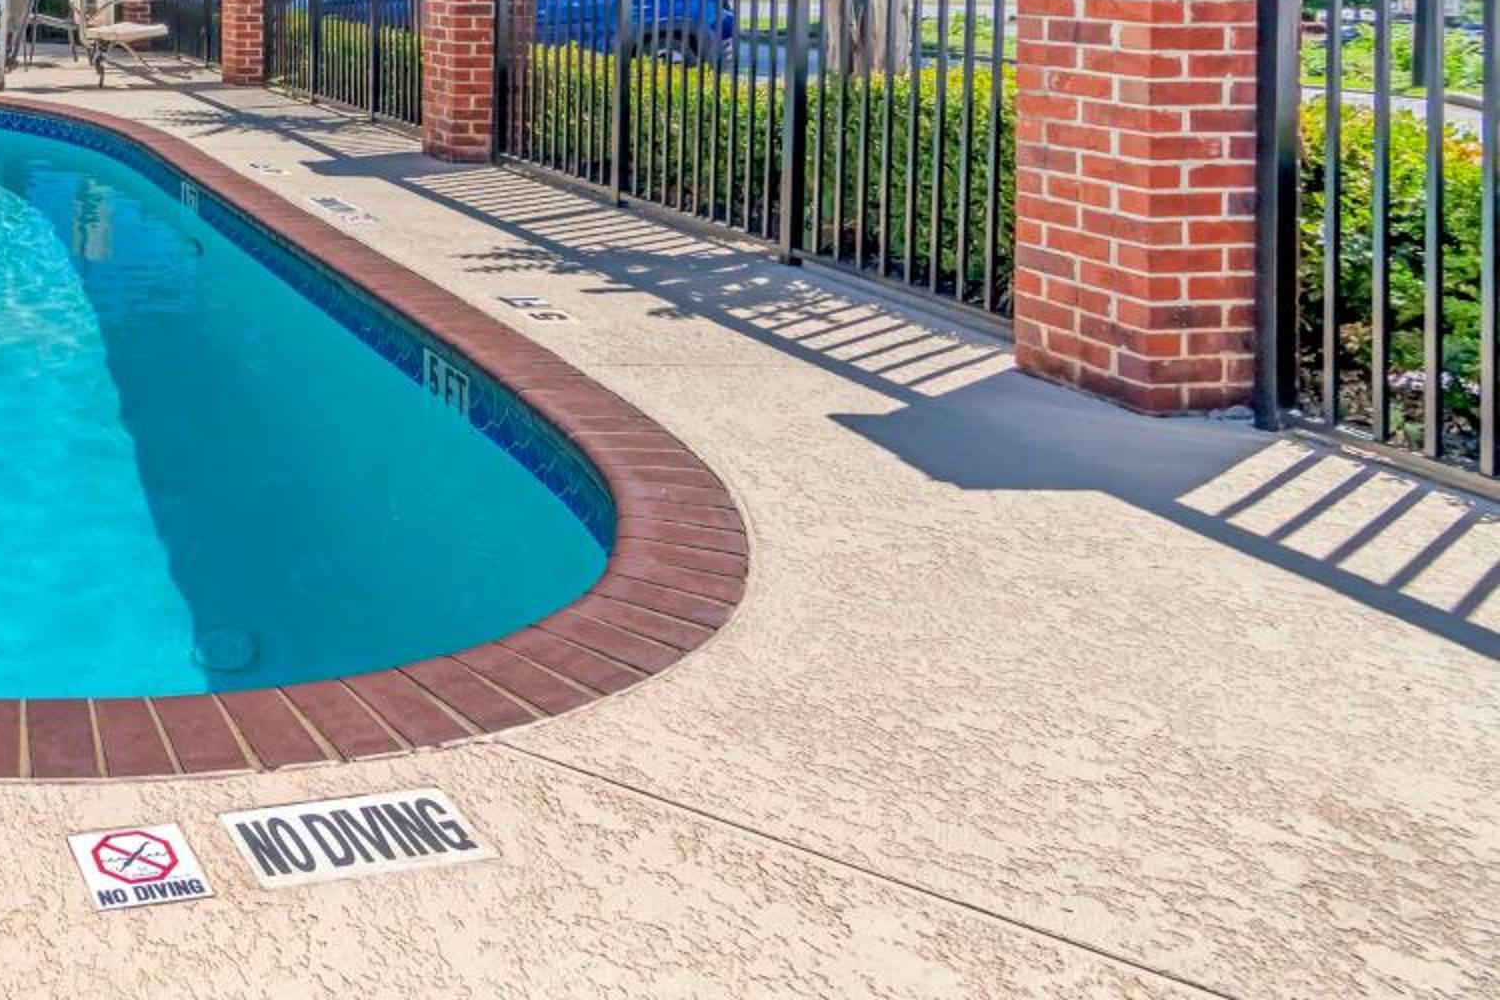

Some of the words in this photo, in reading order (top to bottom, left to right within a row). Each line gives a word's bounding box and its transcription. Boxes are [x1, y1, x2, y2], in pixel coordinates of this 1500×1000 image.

[445, 366, 467, 417] FT
[235, 816, 317, 877] NO
[298, 797, 479, 868] DIVING
[96, 887, 129, 907] NO
[132, 878, 206, 902] DIVING
